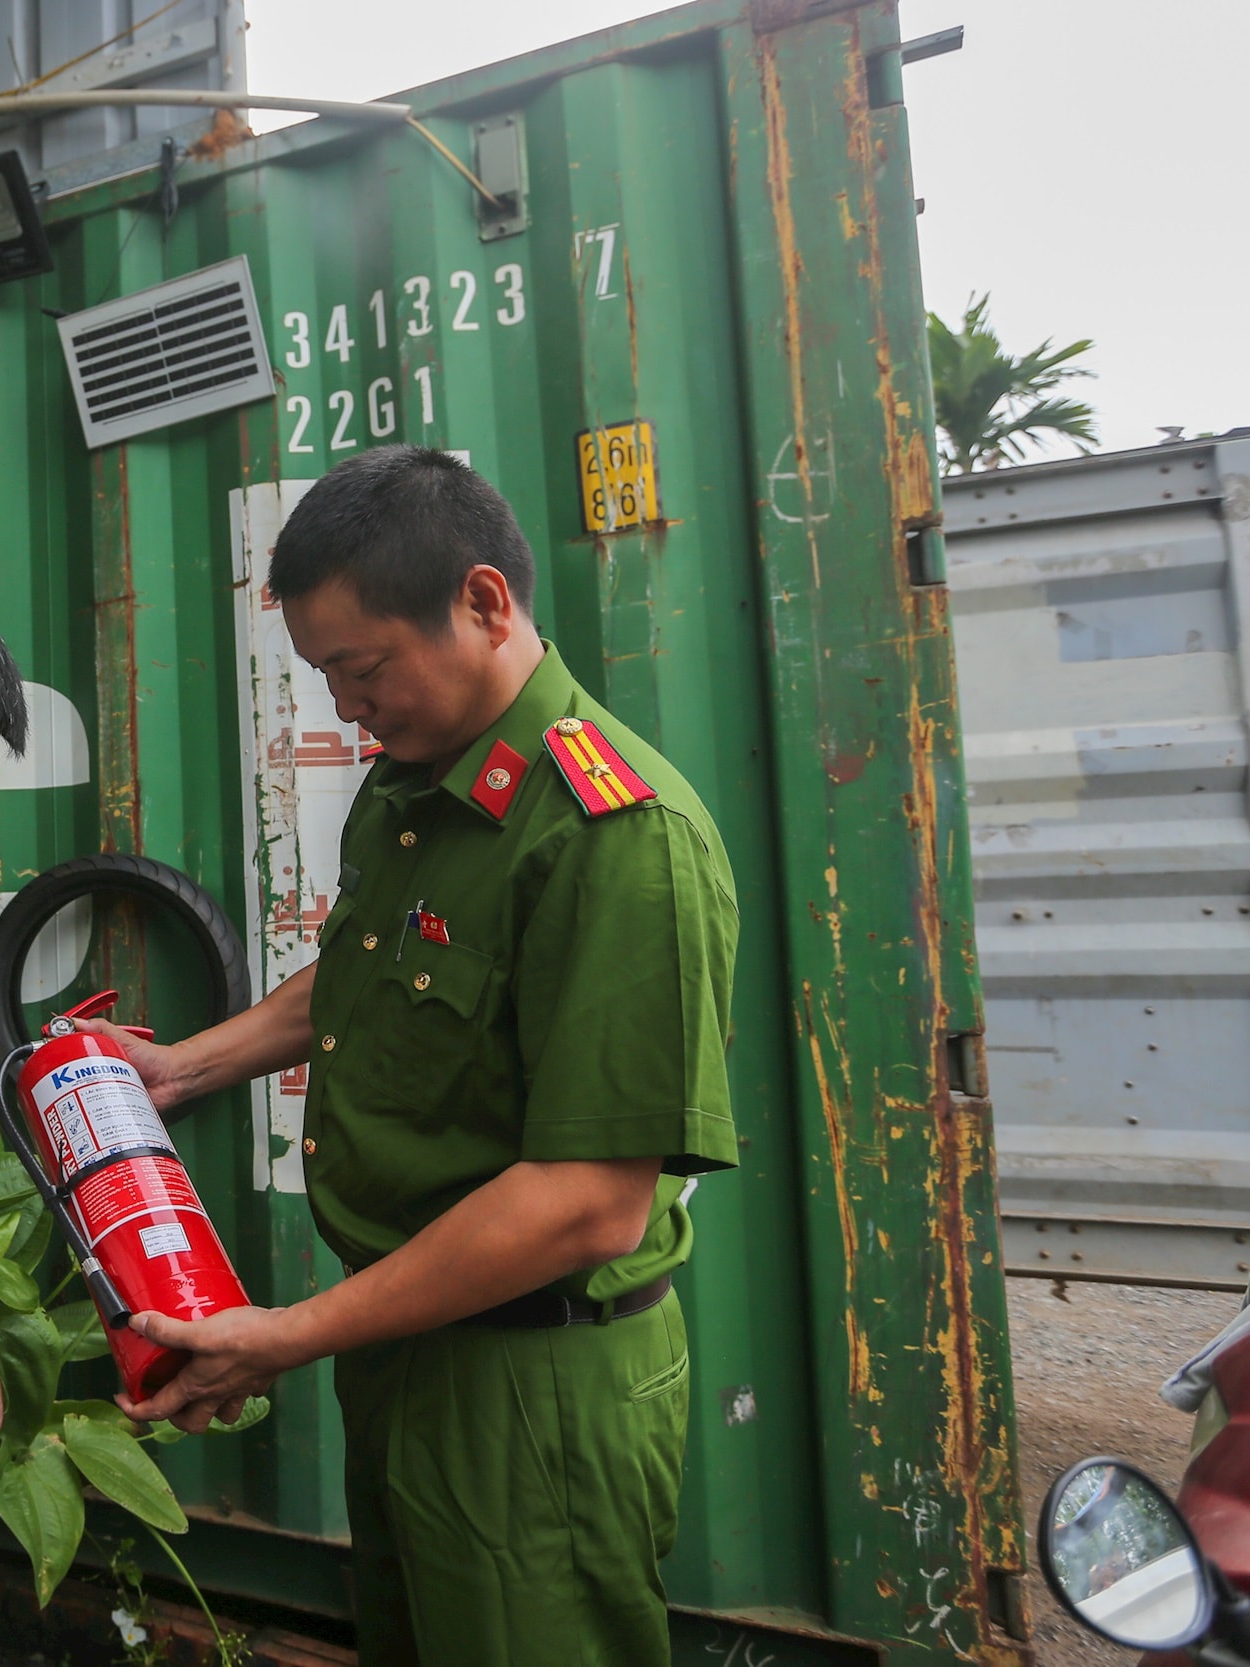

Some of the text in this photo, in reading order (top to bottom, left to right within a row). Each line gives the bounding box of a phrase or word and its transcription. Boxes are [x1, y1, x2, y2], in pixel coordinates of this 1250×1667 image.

[286, 365, 435, 454] 22G1
[51, 1065, 131, 1090] KINGDOM
[46, 1107, 71, 1159] POWDER
